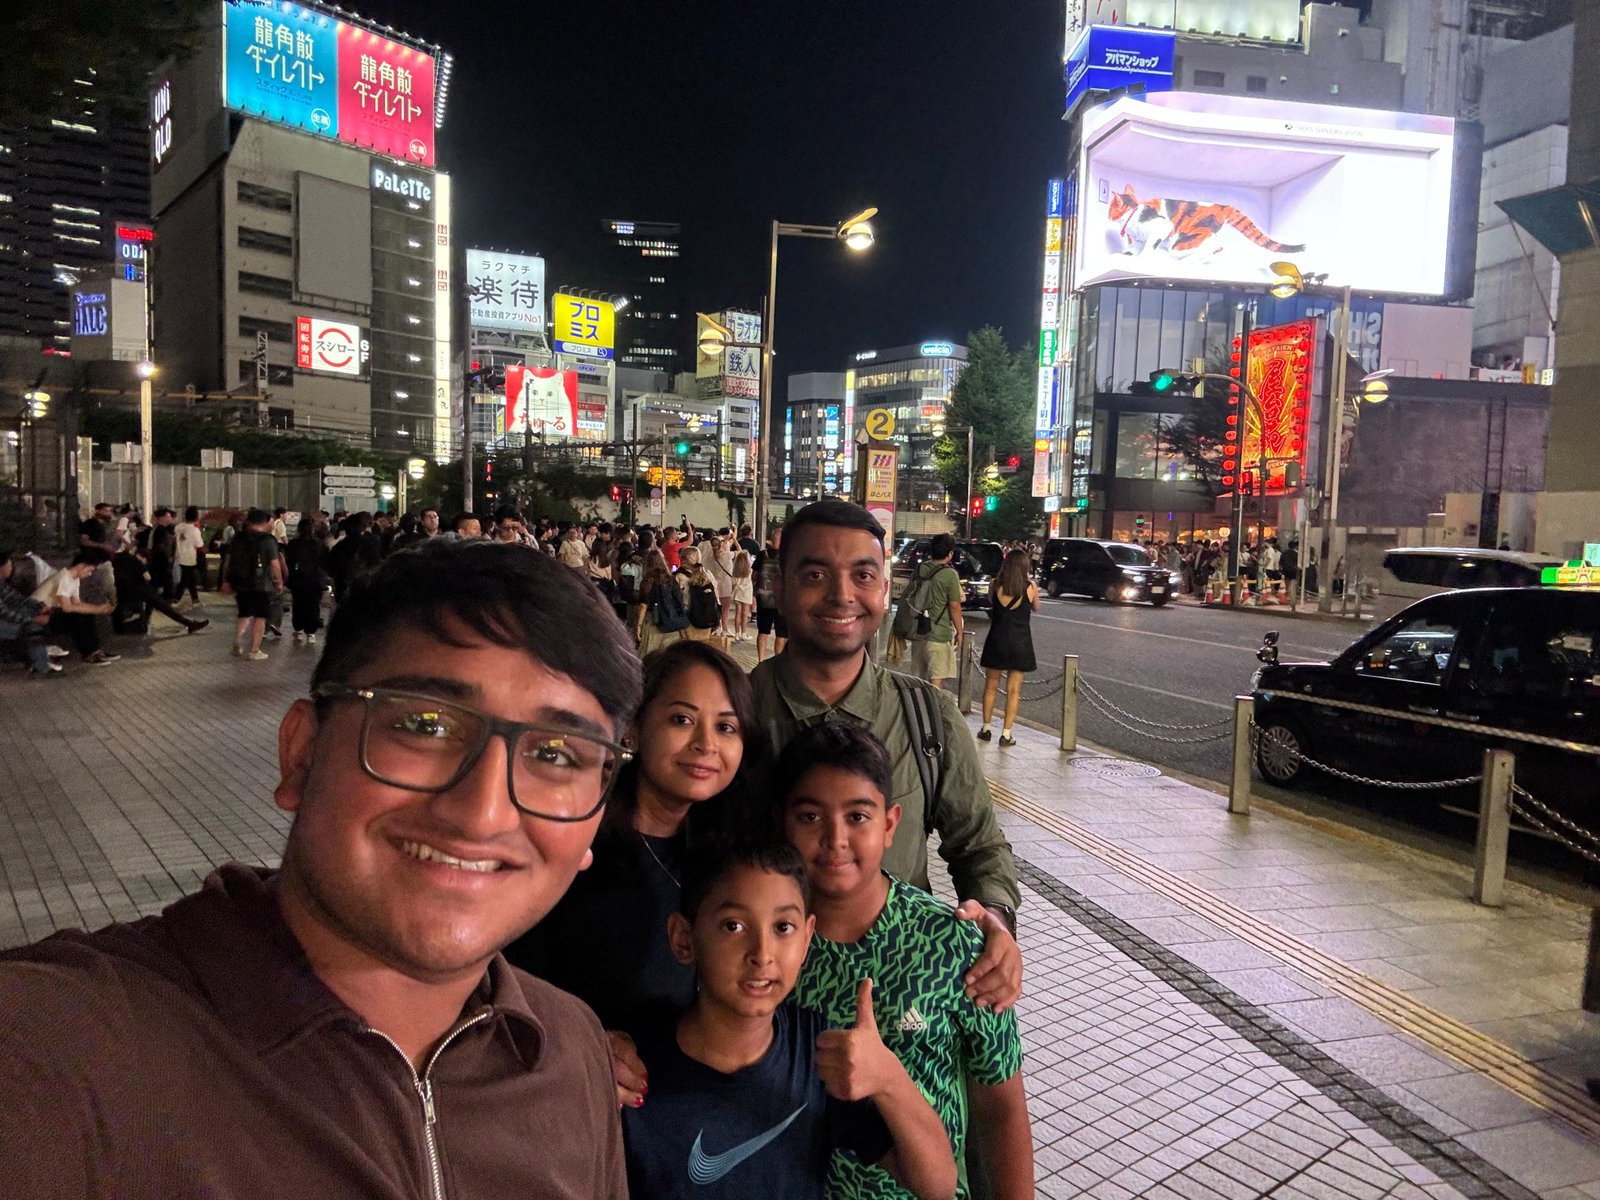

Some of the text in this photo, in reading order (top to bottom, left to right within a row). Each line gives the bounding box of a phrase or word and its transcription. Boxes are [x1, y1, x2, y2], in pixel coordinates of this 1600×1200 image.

[254, 15, 314, 62] 龍角散
[245, 44, 325, 91] ダイレクト
[1105, 52, 1159, 68] アパマンショップ
[360, 54, 413, 96] 龍角散
[154, 80, 171, 123] UNI
[353, 81, 422, 124] ダイレクト
[154, 117, 172, 164] QLO
[481, 260, 531, 275] ラクマチ
[473, 275, 539, 309] 楽待
[570, 301, 600, 322] プロ
[570, 321, 600, 341] ミス
[728, 315, 761, 341] カラオケ
[299, 322, 310, 364] 回転寿司
[315, 340, 356, 354] スシロー
[570, 344, 593, 354] プロミス
[729, 352, 757, 376] 鉄人
[872, 412, 889, 435] 2
[870, 490, 892, 499] はとバス
[896, 1020, 928, 1031] adidas
